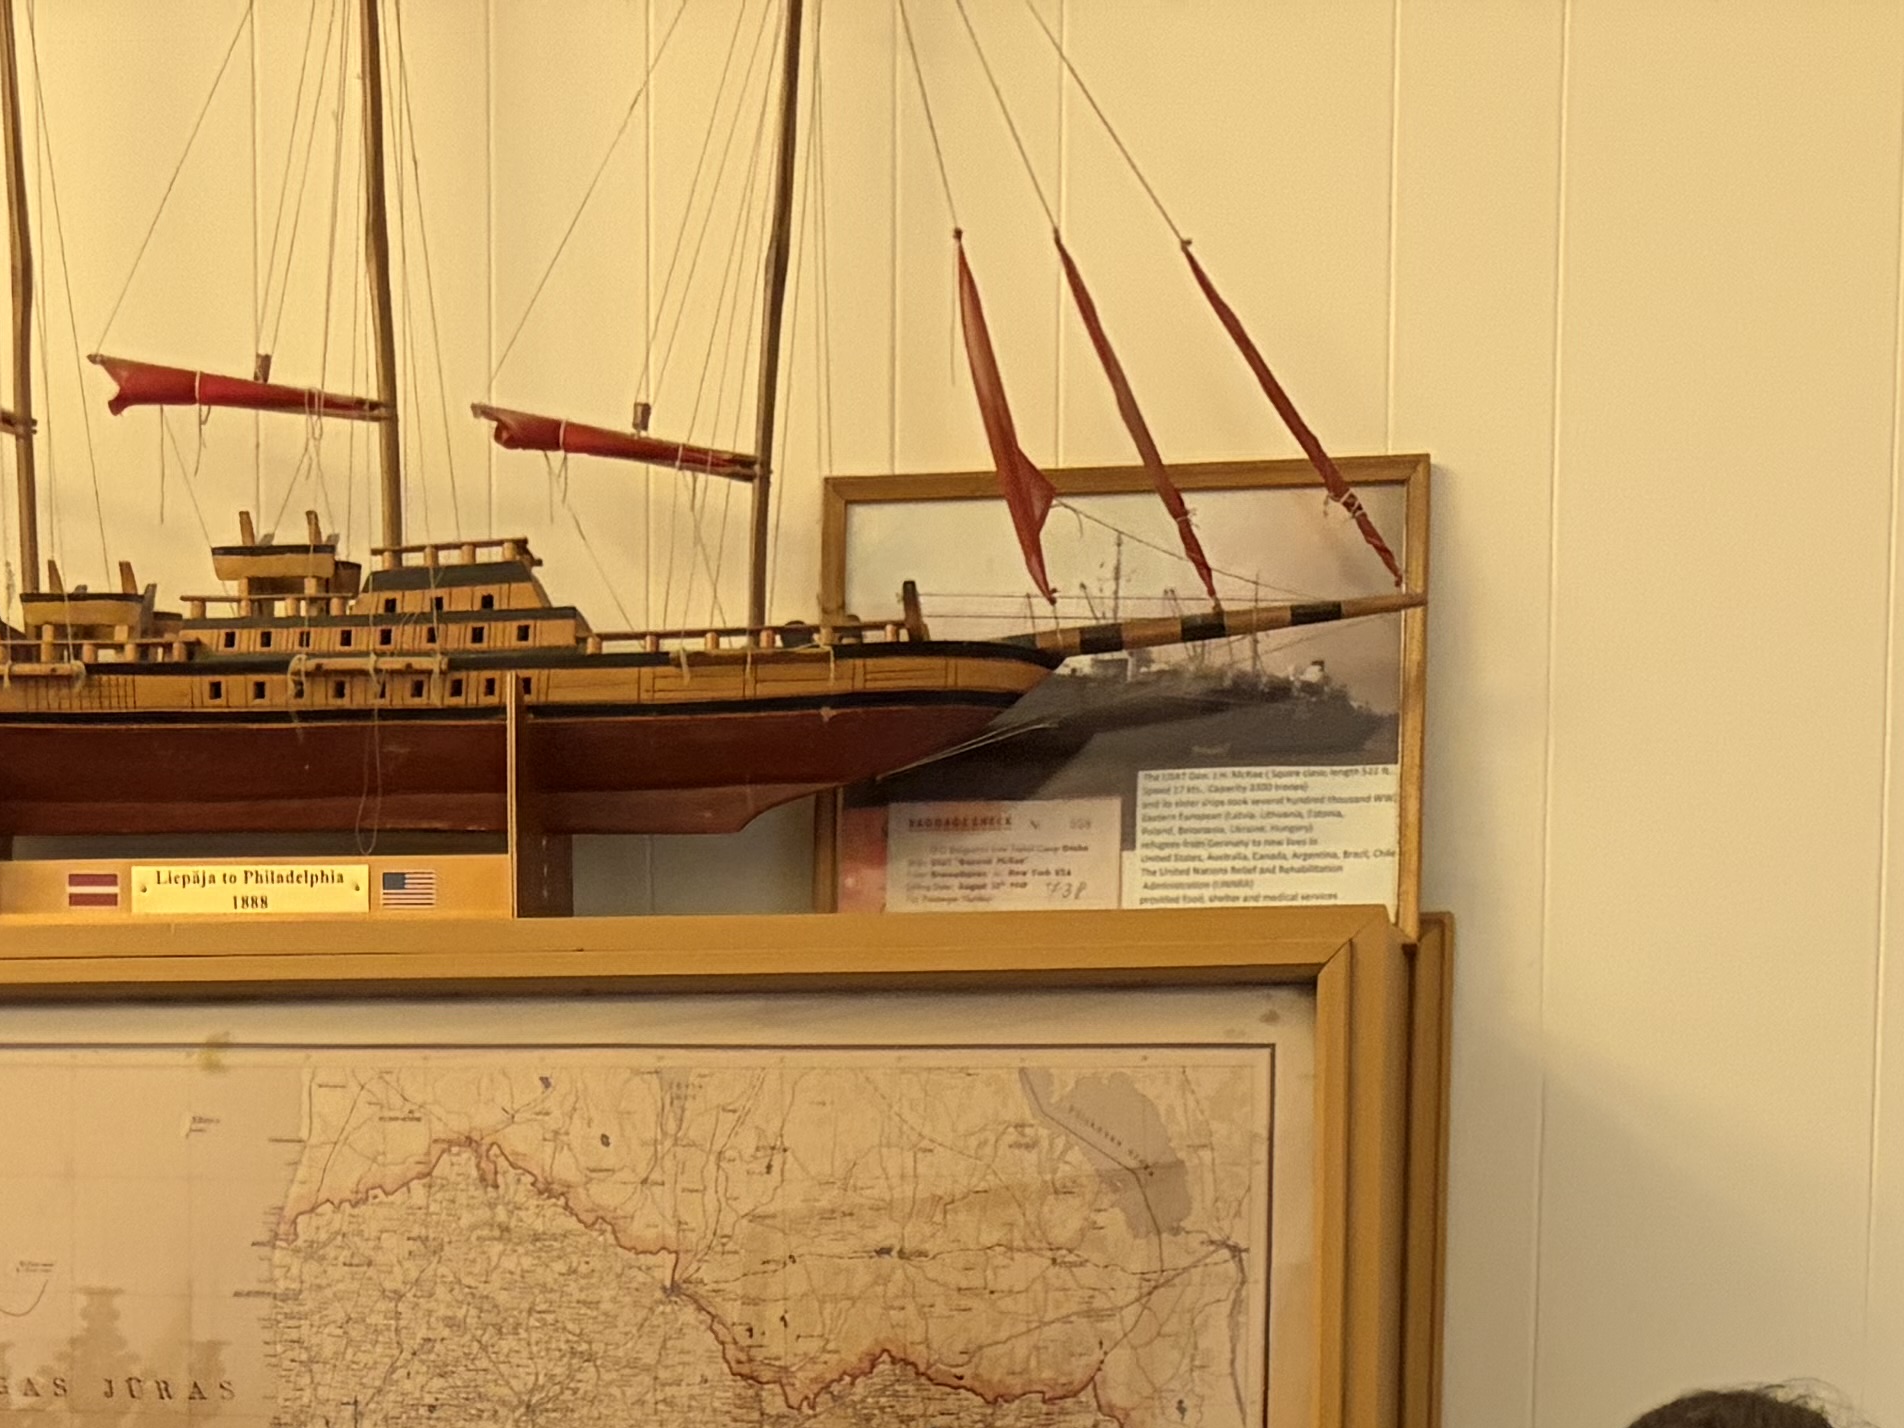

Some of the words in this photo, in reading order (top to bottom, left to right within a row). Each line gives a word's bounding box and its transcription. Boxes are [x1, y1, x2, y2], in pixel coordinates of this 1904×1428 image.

[1207, 784, 1247, 795] Capacity
[1285, 795, 1326, 806] hundred
[1327, 794, 1372, 804] thousand
[1291, 849, 1341, 861] Argentina,
[1141, 867, 1157, 877] The
[1158, 866, 1191, 877] United
[1192, 866, 1229, 877] Nations
[1230, 865, 1258, 876] Relief
[1258, 864, 1277, 875] and
[1278, 864, 1344, 875] Rehabilitation
[222, 871, 238, 885] to
[243, 868, 345, 889] Philadelphia
[1143, 882, 1210, 891] Administration
[233, 894, 269, 911] 1888
[1208, 893, 1240, 904] shelter
[1242, 892, 1262, 903] and
[1262, 891, 1298, 902] medical
[1299, 891, 1339, 902] services
